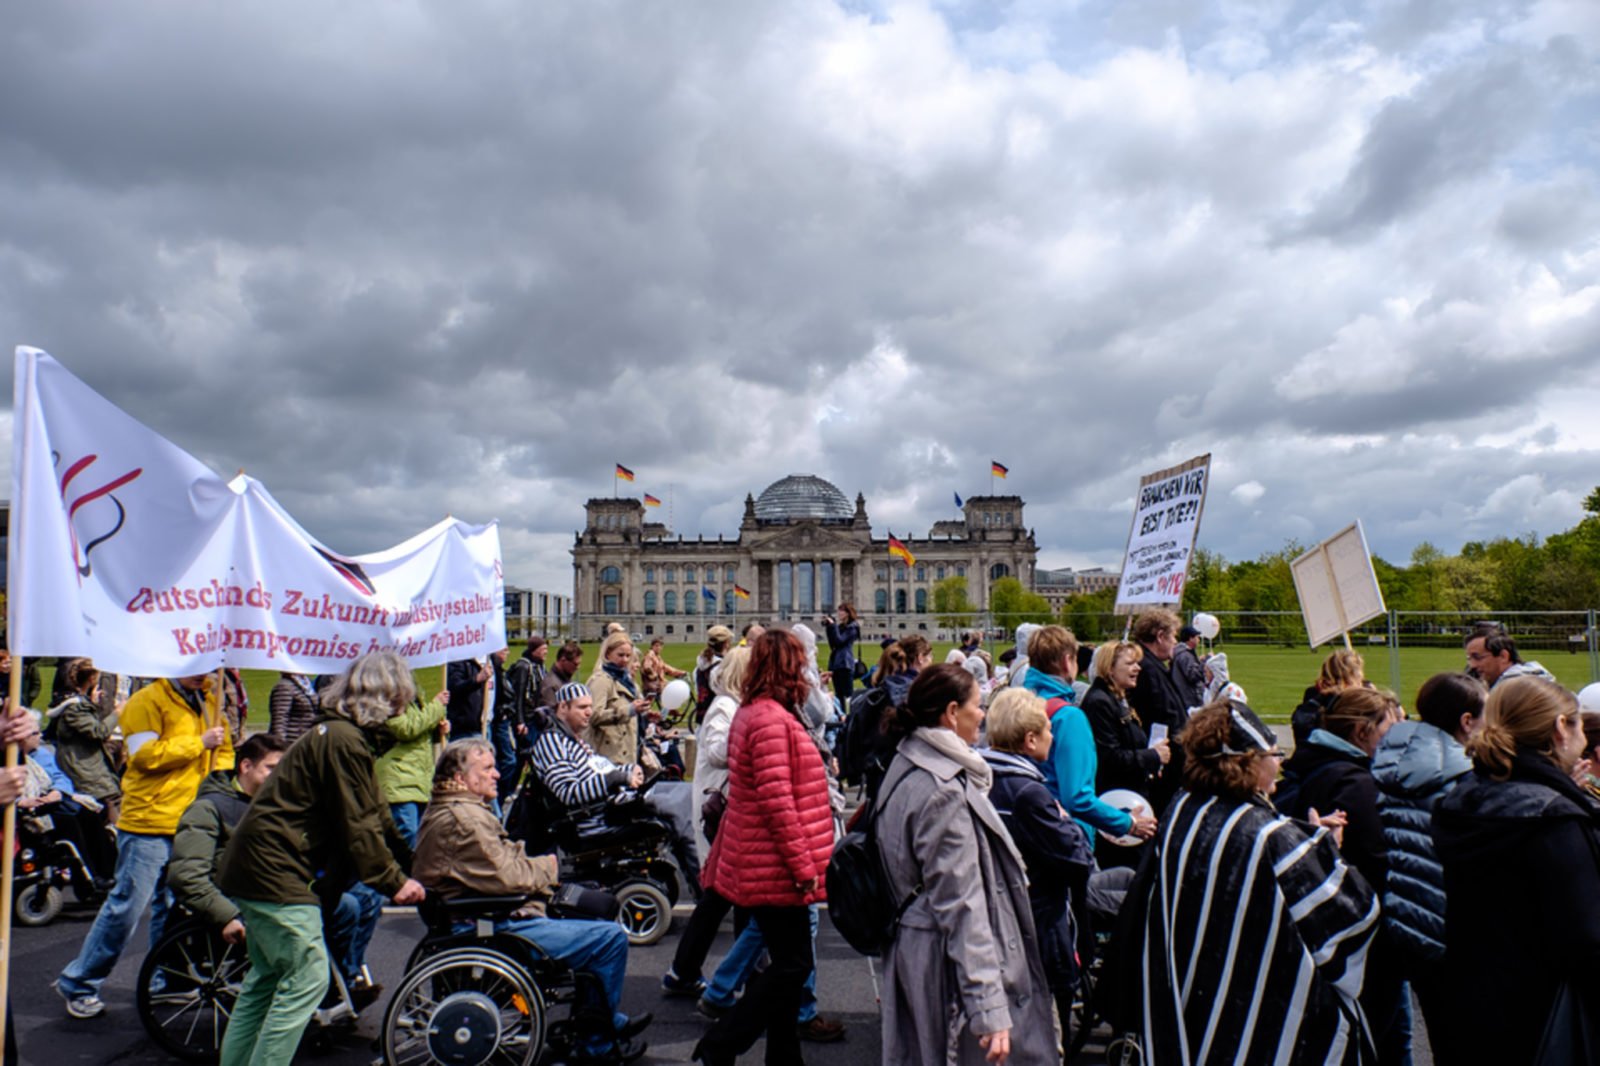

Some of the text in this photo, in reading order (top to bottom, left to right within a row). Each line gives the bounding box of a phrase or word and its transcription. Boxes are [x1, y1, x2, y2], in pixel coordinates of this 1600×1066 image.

[1140, 469, 1204, 512] BRAUCHEN WIR
[1140, 510, 1165, 537] ERST
[126, 578, 272, 613] eutschnds
[280, 589, 390, 627] Zukunft
[218, 624, 361, 660] ompromiss
[400, 636, 427, 657] der
